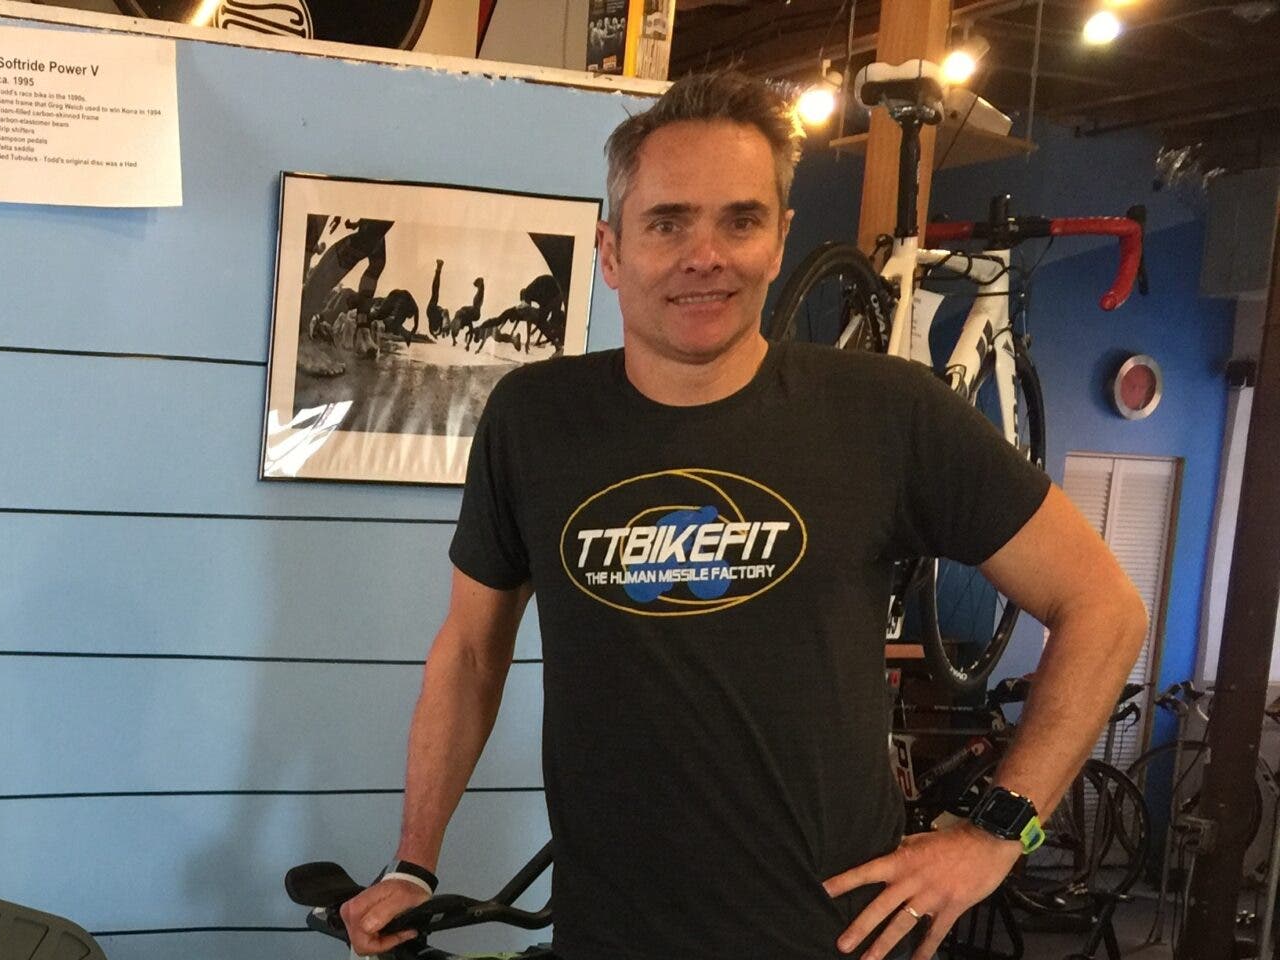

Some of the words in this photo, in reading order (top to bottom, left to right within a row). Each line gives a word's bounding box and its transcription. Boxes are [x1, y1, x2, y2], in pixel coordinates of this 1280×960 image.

[49, 61, 88, 76] Power
[90, 65, 100, 77] V
[13, 76, 35, 87] 1995
[34, 91, 47, 99] bike
[576, 521, 791, 569] TTBIKEFIT
[585, 571, 608, 586] THE
[610, 570, 657, 585] HUMAN
[659, 567, 710, 583] MISSILE
[712, 563, 776, 582] FACTORY
